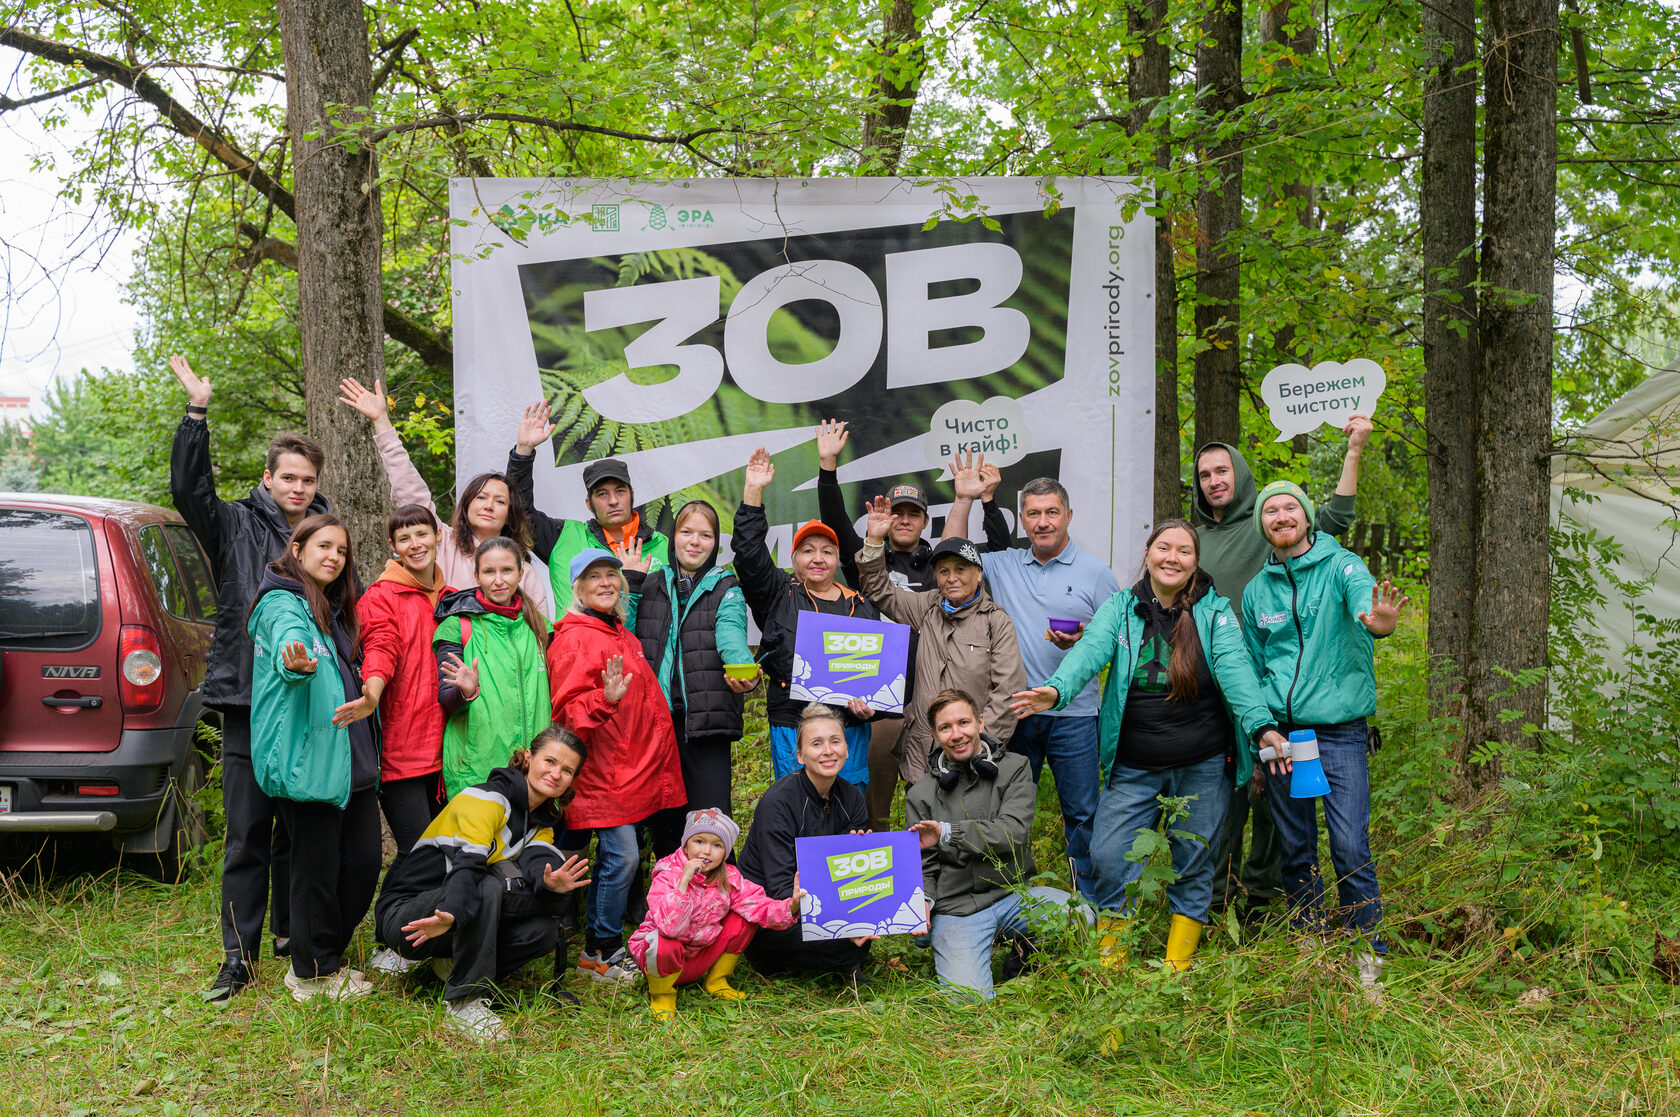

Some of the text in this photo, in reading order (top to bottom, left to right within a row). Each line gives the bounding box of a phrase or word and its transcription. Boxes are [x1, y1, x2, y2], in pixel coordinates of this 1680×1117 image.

[677, 209, 715, 223] ЭРА
[1102, 225, 1125, 397] zovprirody.org
[581, 242, 1031, 424] ЗОВ
[1278, 375, 1366, 399] Бережем
[1286, 395, 1361, 415] чистоту
[945, 417, 1009, 434] Чисто
[940, 433, 1018, 456] в кайф!
[827, 635, 878, 651] ЗОВ
[44, 666, 98, 678] NIVA
[830, 662, 877, 670] ПРИРОДЫ
[833, 850, 889, 877] ЗОВ
[841, 880, 890, 897] ПРИРОДЫ
